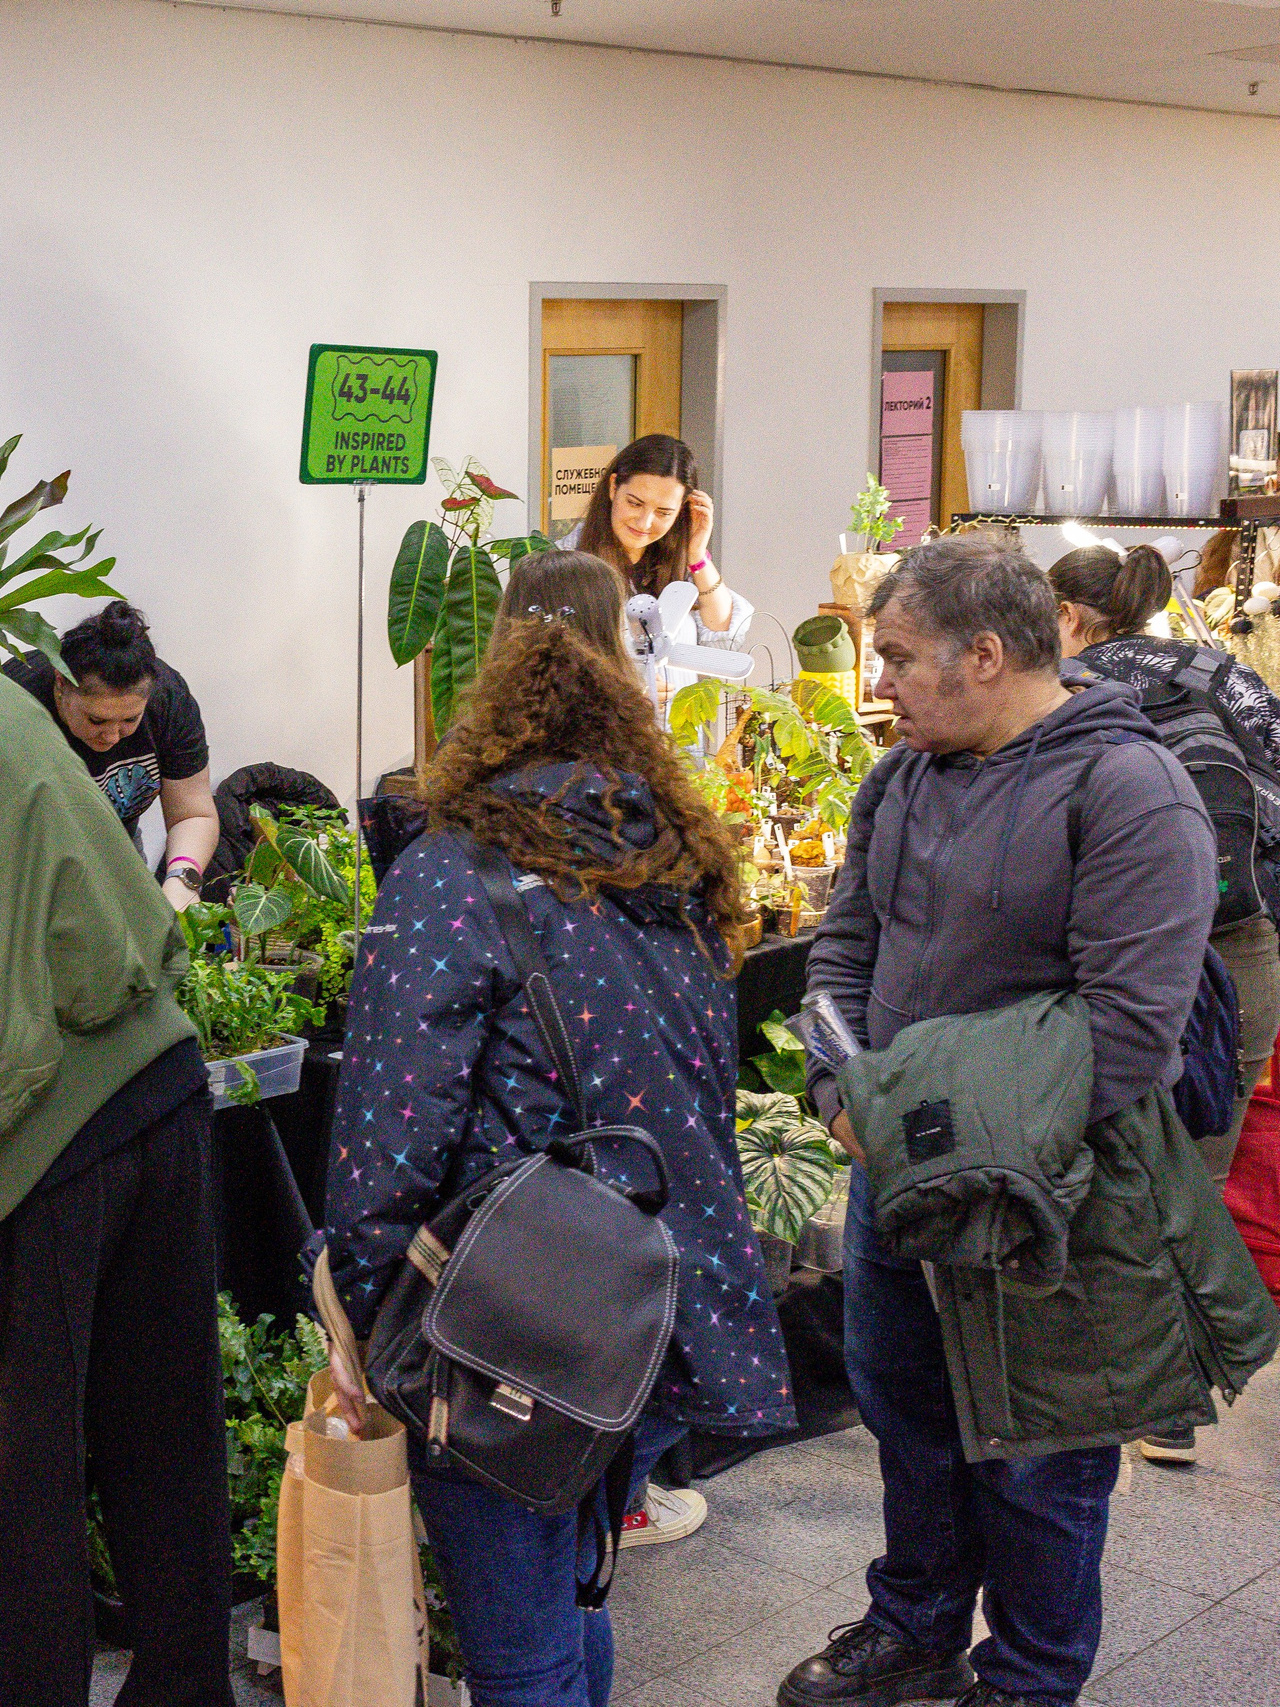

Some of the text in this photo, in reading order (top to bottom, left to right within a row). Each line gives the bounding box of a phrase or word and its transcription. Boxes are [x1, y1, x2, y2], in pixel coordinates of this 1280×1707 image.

[337, 373, 411, 406] 43-44
[884, 396, 932, 411] ЛЕКТОРИЙ 2
[334, 431, 406, 452] INSPIRED
[326, 454, 410, 475] BY PLANTS
